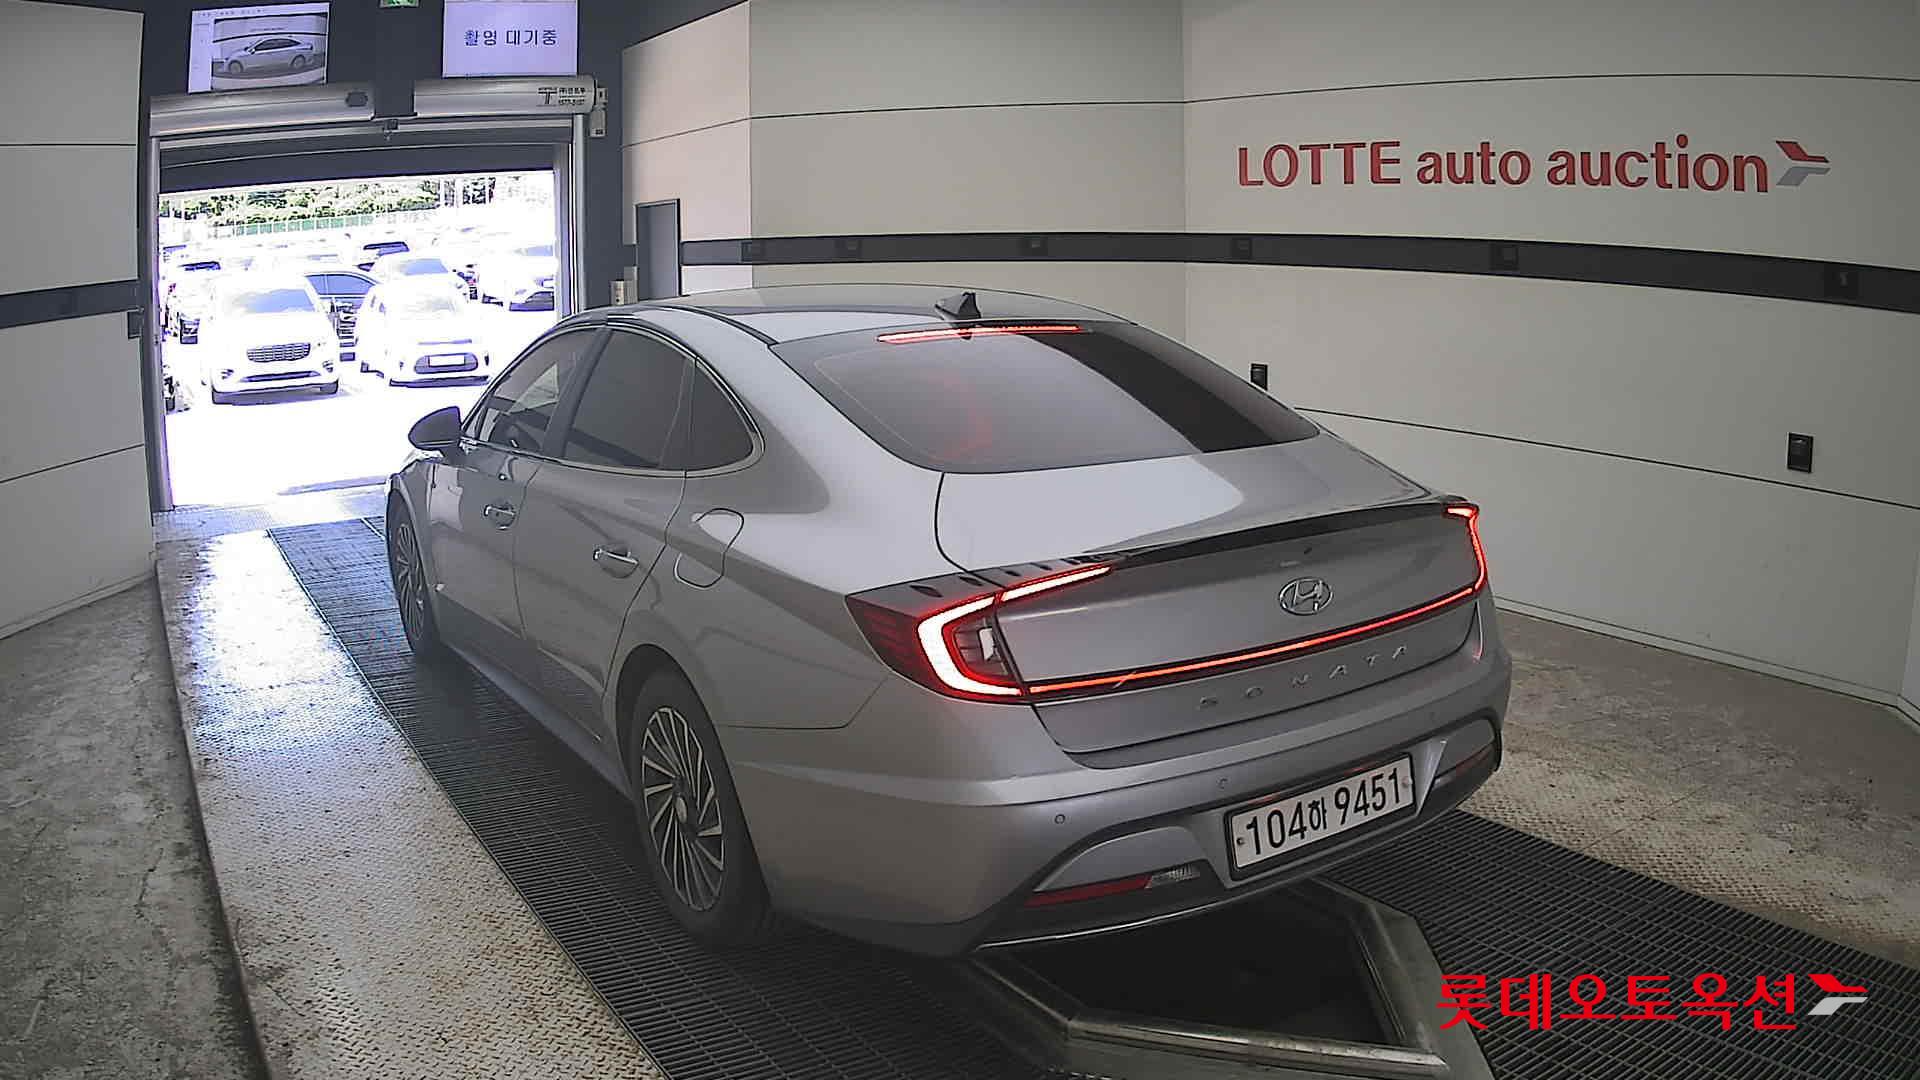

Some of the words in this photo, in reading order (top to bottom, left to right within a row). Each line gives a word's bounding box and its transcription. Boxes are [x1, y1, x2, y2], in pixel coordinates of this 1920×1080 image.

[505, 29, 557, 46] 대기중
[1238, 140, 1401, 187] LOTTE
[1416, 141, 1531, 186] auto
[1546, 134, 1769, 193] auction
[1246, 797, 1327, 855] 104하
[1334, 768, 1400, 825] 9451
